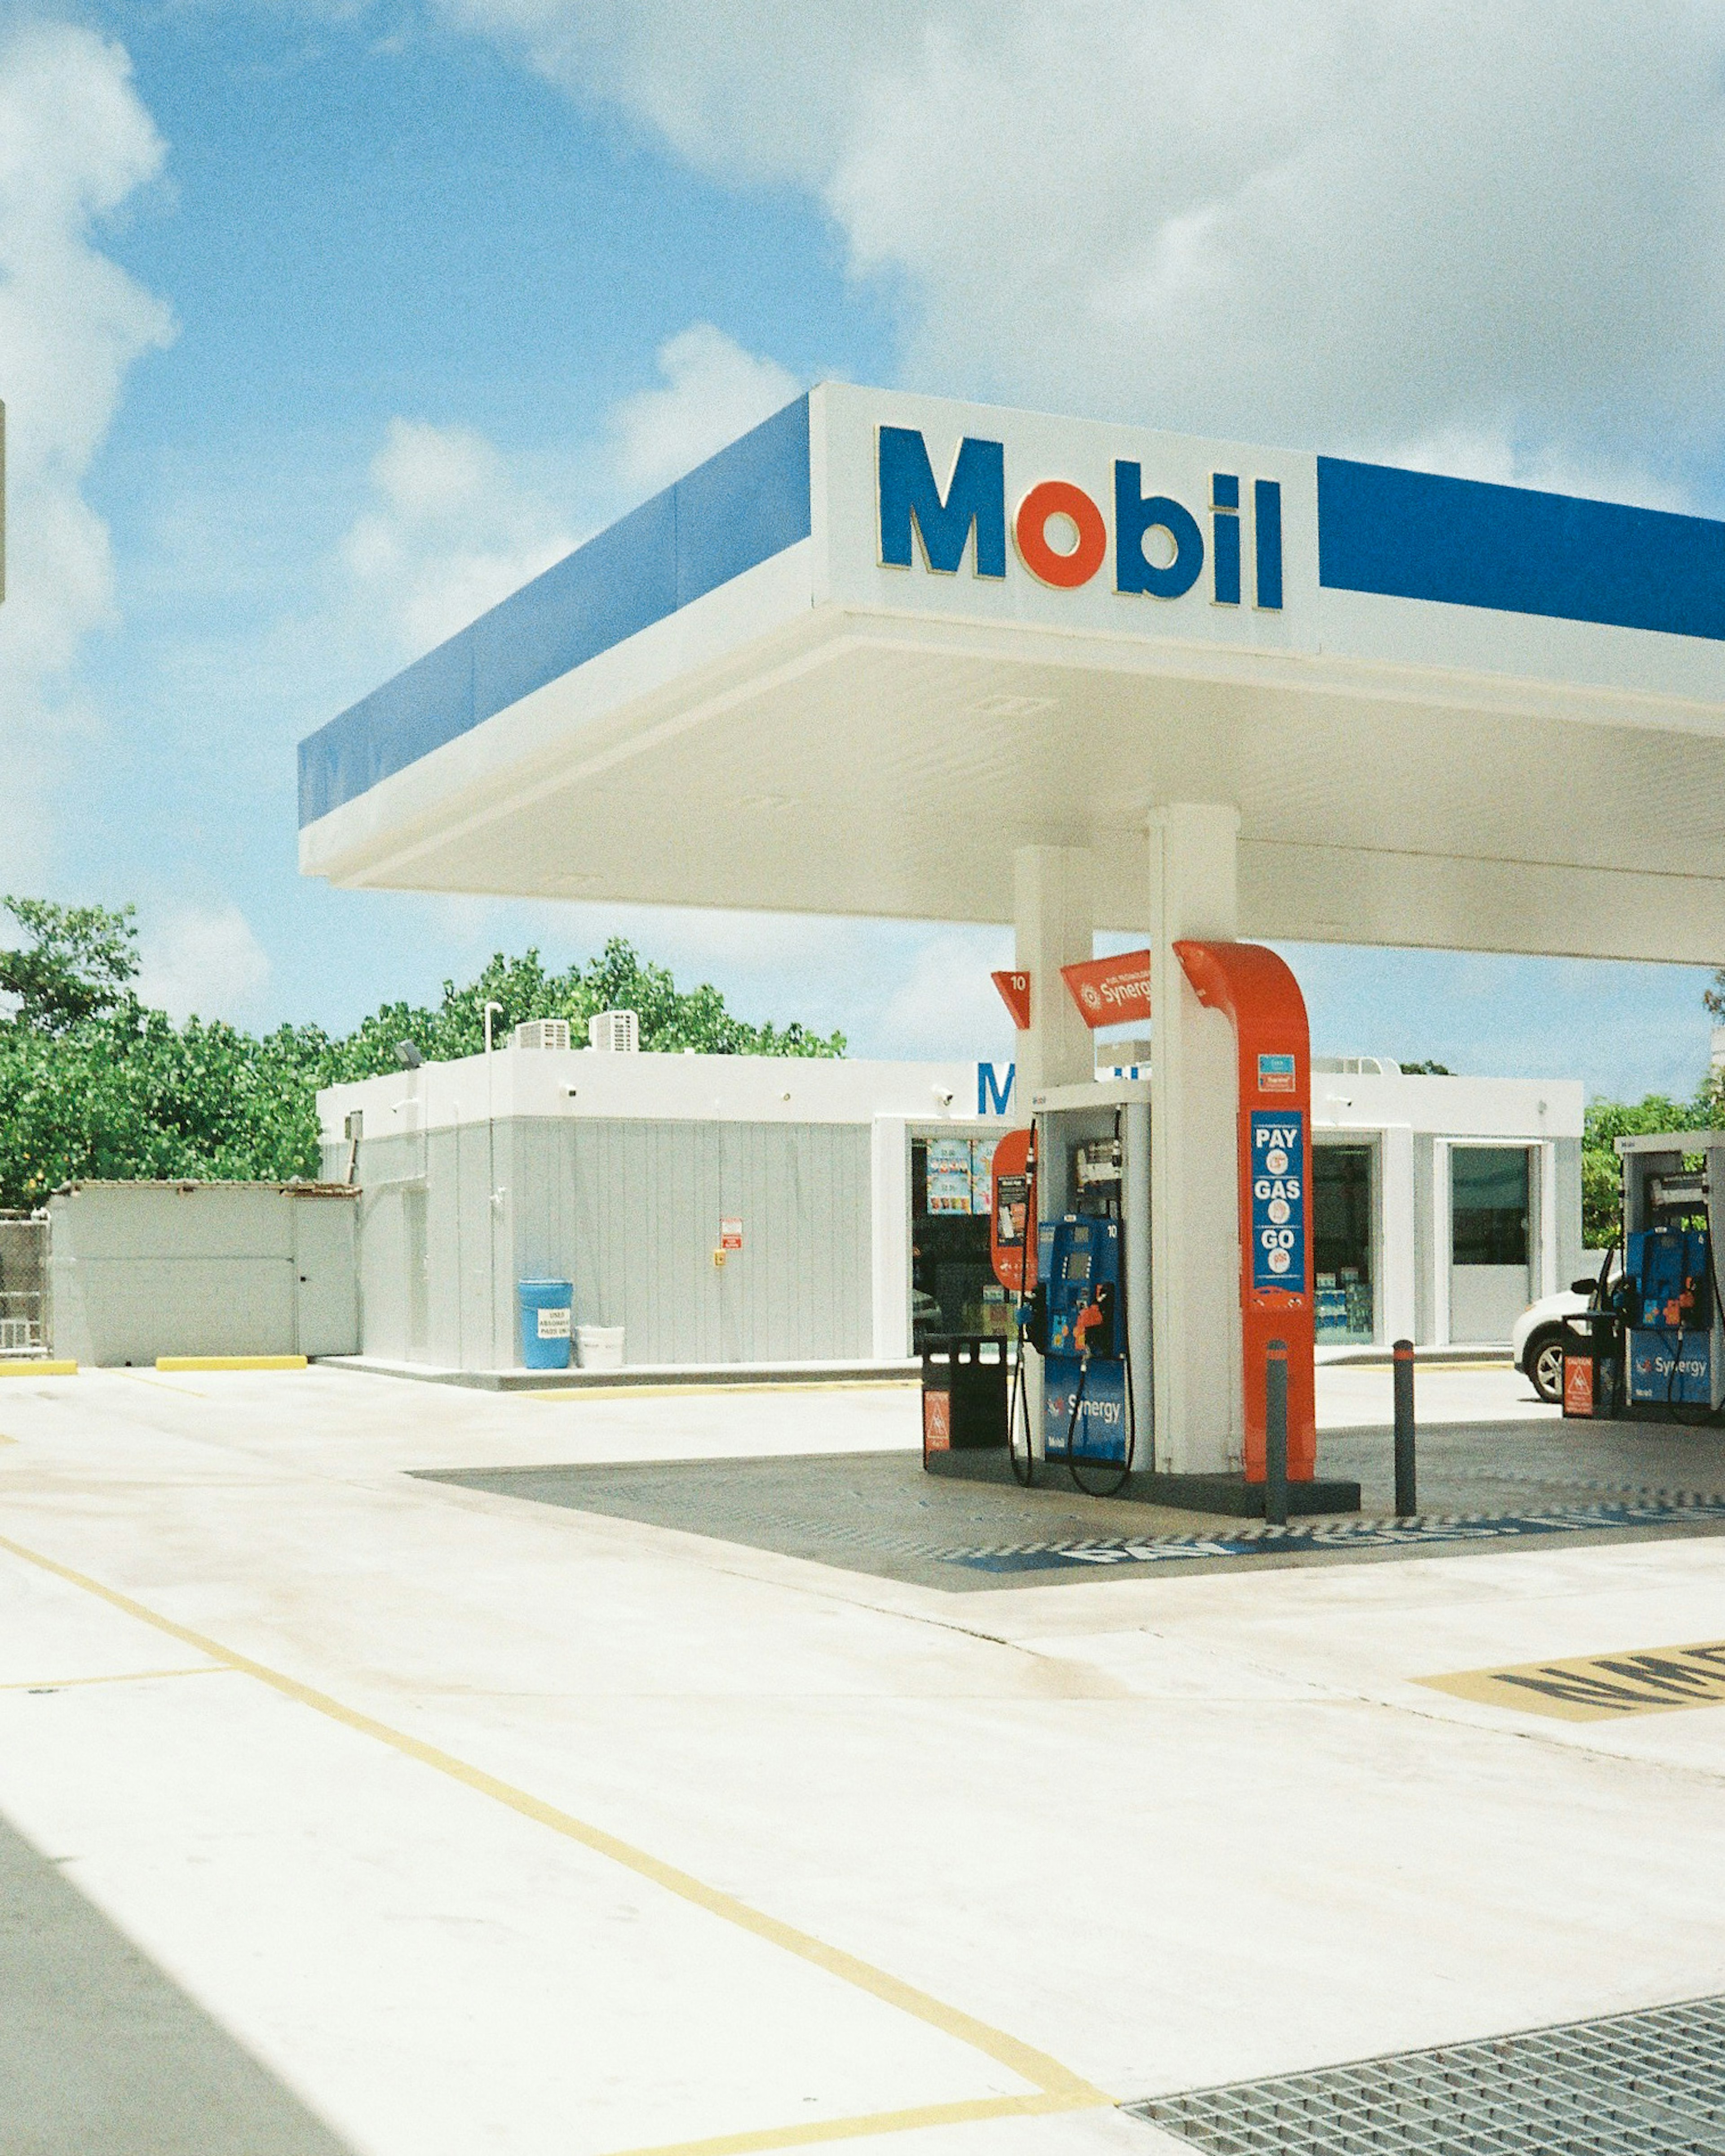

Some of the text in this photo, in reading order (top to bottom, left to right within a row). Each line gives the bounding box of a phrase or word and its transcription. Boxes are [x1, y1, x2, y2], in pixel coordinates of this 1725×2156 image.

[874, 424, 1283, 613] Mobil
[1010, 975, 1026, 991] 10
[1100, 981, 1150, 1007] Synerg
[1256, 1129, 1297, 1148] PAY
[1255, 1179, 1300, 1200] GAS
[1107, 1225, 1117, 1238] 10
[1261, 1229, 1295, 1249] GO
[1068, 1394, 1121, 1424] Synergy
[1489, 1646, 1725, 1710] NM
